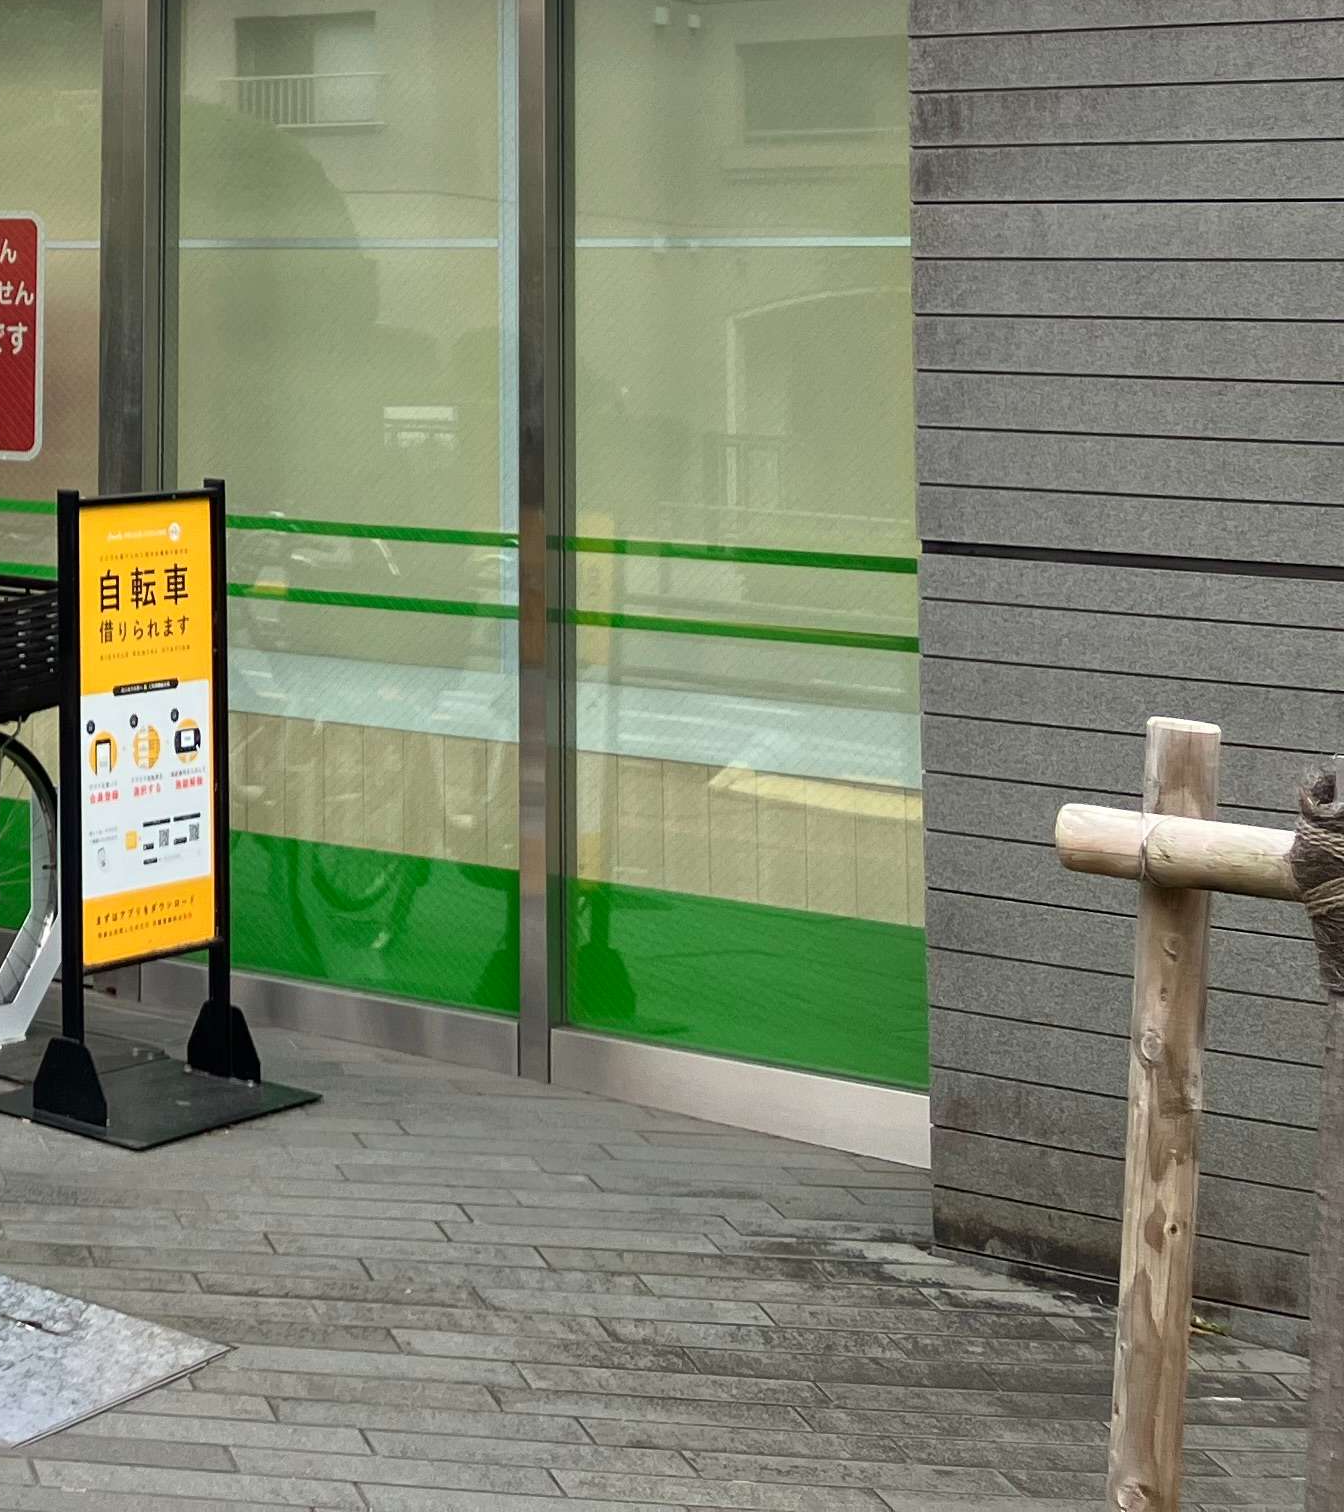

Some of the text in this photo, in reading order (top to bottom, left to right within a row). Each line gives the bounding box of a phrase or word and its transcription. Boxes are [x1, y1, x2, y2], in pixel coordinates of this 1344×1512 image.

[100, 563, 189, 613] 自転車
[99, 615, 190, 644] 借りられます
